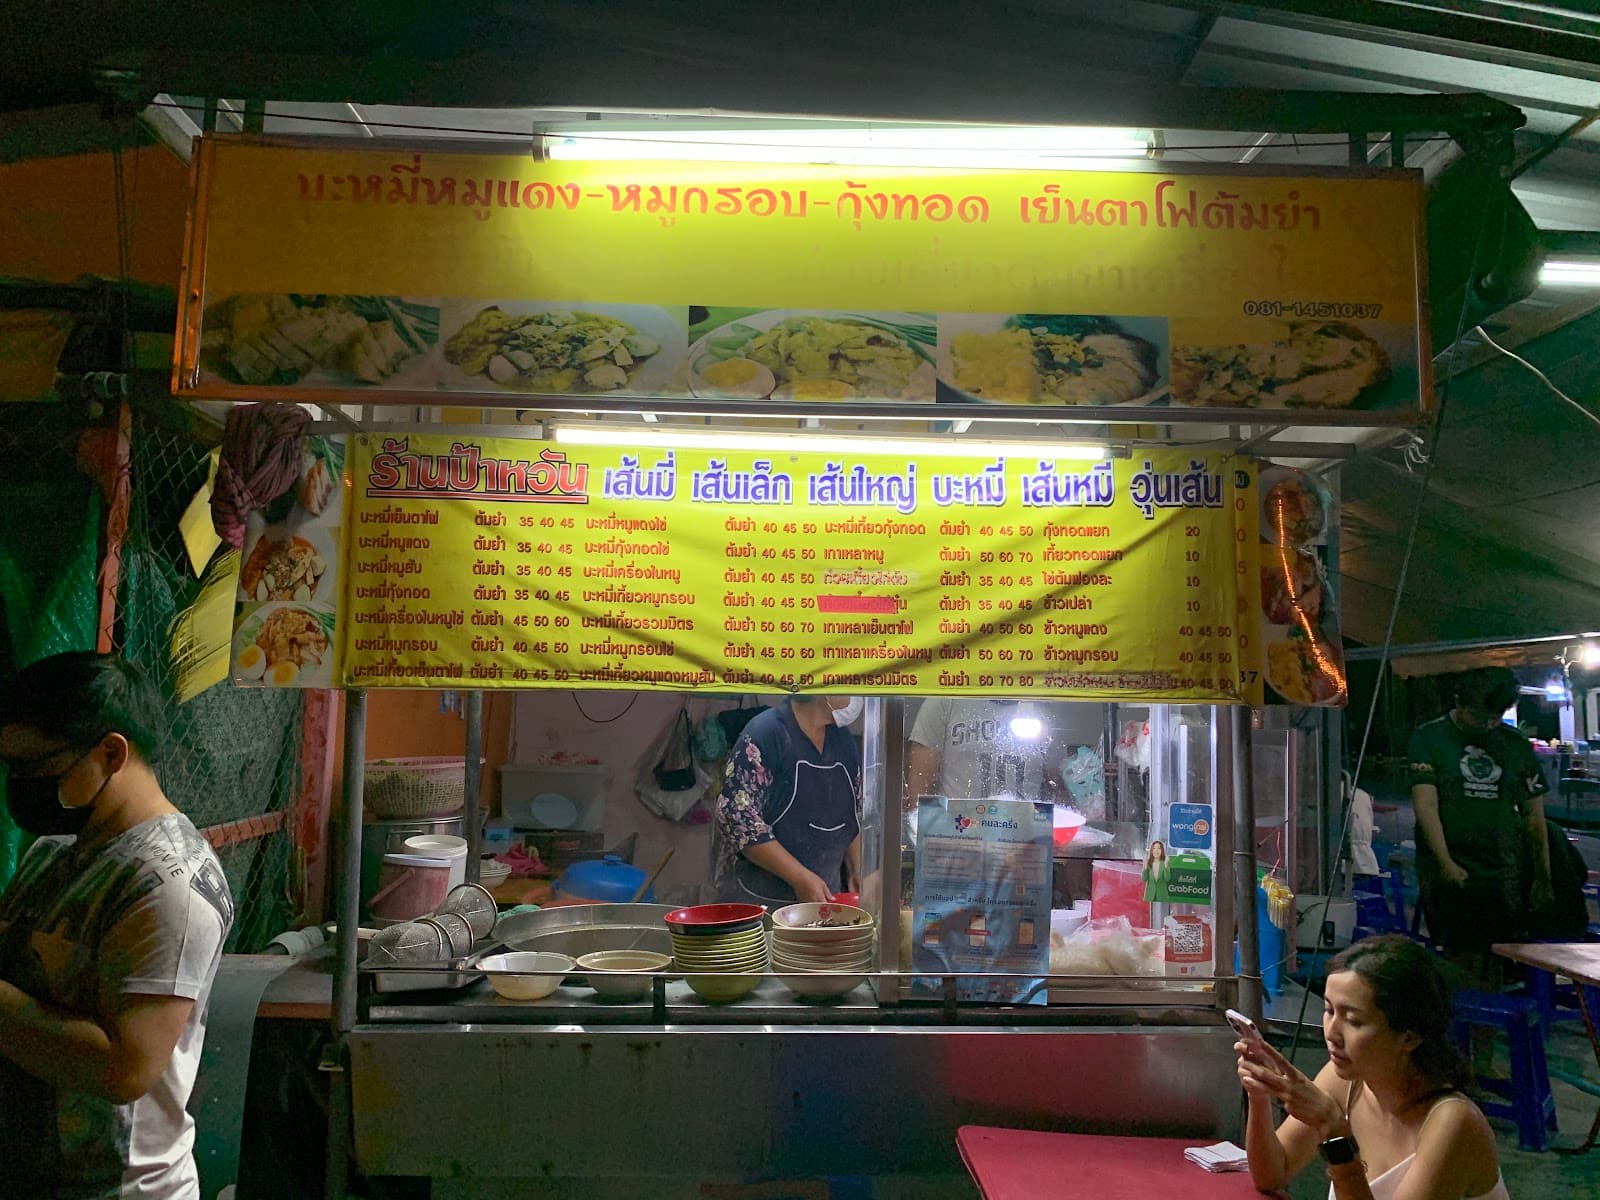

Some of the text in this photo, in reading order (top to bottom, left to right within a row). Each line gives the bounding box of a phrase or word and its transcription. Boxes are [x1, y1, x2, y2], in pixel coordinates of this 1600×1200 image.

[1019, 180, 1322, 232] เย็นตาโฟต้มยำ
[1243, 300, 1383, 319] 081-1451037
[368, 436, 590, 495] ร้านป้าหวัน
[690, 455, 794, 505] เส้นเล็ก
[808, 459, 918, 515] เส้นใหญ่
[931, 456, 1008, 507] บะหมี่
[360, 504, 575, 529] บะหมี่เย็นตาโฟ ต้มยำ 35 40 45
[586, 512, 817, 534] บะหมี่หมูแดงไข่ ต้มยำ 40 45 50
[938, 519, 970, 536] ต้มยำ
[979, 525, 994, 536] 40
[999, 525, 1014, 536] 45
[1019, 525, 1033, 536] 50
[1043, 521, 1201, 541] กุ้งทอดแยก 20
[358, 529, 573, 555] บะหมี่หมูแดง ต้มยำ 35 40 45
[584, 536, 816, 560] บะหมี่กุ้งทอดไข่ ต้มยำ 40 45 50
[824, 546, 1034, 564] เกาเหลาหมู ต้มยำ 50 60 70
[1185, 550, 1200, 562] 10
[358, 555, 572, 577] บะหมี่หมูสับ ต้มยำ 35 40 45
[584, 560, 680, 584] บะหมี่เครื่องในหมู
[723, 567, 755, 583] ต้มยำ
[760, 572, 776, 583] 40
[780, 572, 795, 584] 45
[799, 572, 815, 584] 50
[939, 570, 1032, 587] ต้มยำ 35 40 45
[1042, 570, 1201, 588] ไข่ต้มฟองละ 10
[356, 580, 570, 602] บะหมี่กุ้งทอด ต้มยำ 35 40 45
[722, 590, 755, 608] ต้มยำ
[761, 596, 775, 608] 40
[780, 596, 795, 609] 45
[800, 596, 815, 609] 50
[938, 594, 1033, 611] ต้มยำ 35 40 45
[1044, 594, 1200, 612] ข้าวเปล่า 10
[470, 609, 504, 626] ต้มยำ
[513, 615, 529, 626] 45
[533, 615, 550, 627] 50
[553, 615, 570, 627] 60
[723, 616, 756, 632] ต้มยำ
[760, 620, 775, 632] 50
[779, 621, 795, 633] 60
[799, 621, 815, 634] 70
[824, 617, 1033, 636] เกาเหลาเย็นตาโฟ ต้มยำ 40 50 60
[1044, 619, 1232, 641] ข้าวหมูแดง 40 45 50
[355, 632, 569, 655] บะหมี่หมูกรอบ ต้มยำ 40 45 50
[580, 636, 815, 659] บะหมี่หมูกรอบไข่ ต้มยำ 45 50 60
[823, 640, 1033, 664] เกาเหลาเครื่องในหมู ต้มยำ 50 60 70
[1044, 645, 1232, 665] ข้าวหมูกรอบ 40 45 50
[469, 660, 503, 679] ต้มยำ
[511, 667, 528, 680] 40
[532, 668, 549, 681] 45
[553, 667, 569, 681] 50
[721, 667, 755, 684] ต้มยำ
[759, 673, 775, 684] 40
[779, 674, 794, 685] 45
[799, 673, 814, 686] 50
[822, 671, 918, 686] เกาเหลารวมมิตร
[937, 670, 971, 686] ต้มยำ
[978, 674, 994, 686] 60
[998, 673, 1015, 686] 70
[1017, 673, 1034, 686] 80
[1180, 678, 1195, 689] 40
[1199, 678, 1213, 689] 45
[1219, 678, 1233, 690] 50
[981, 817, 1019, 829] คนละครึ่ง
[1172, 823, 1207, 832] wongnai
[1167, 884, 1209, 895] GrabFood
